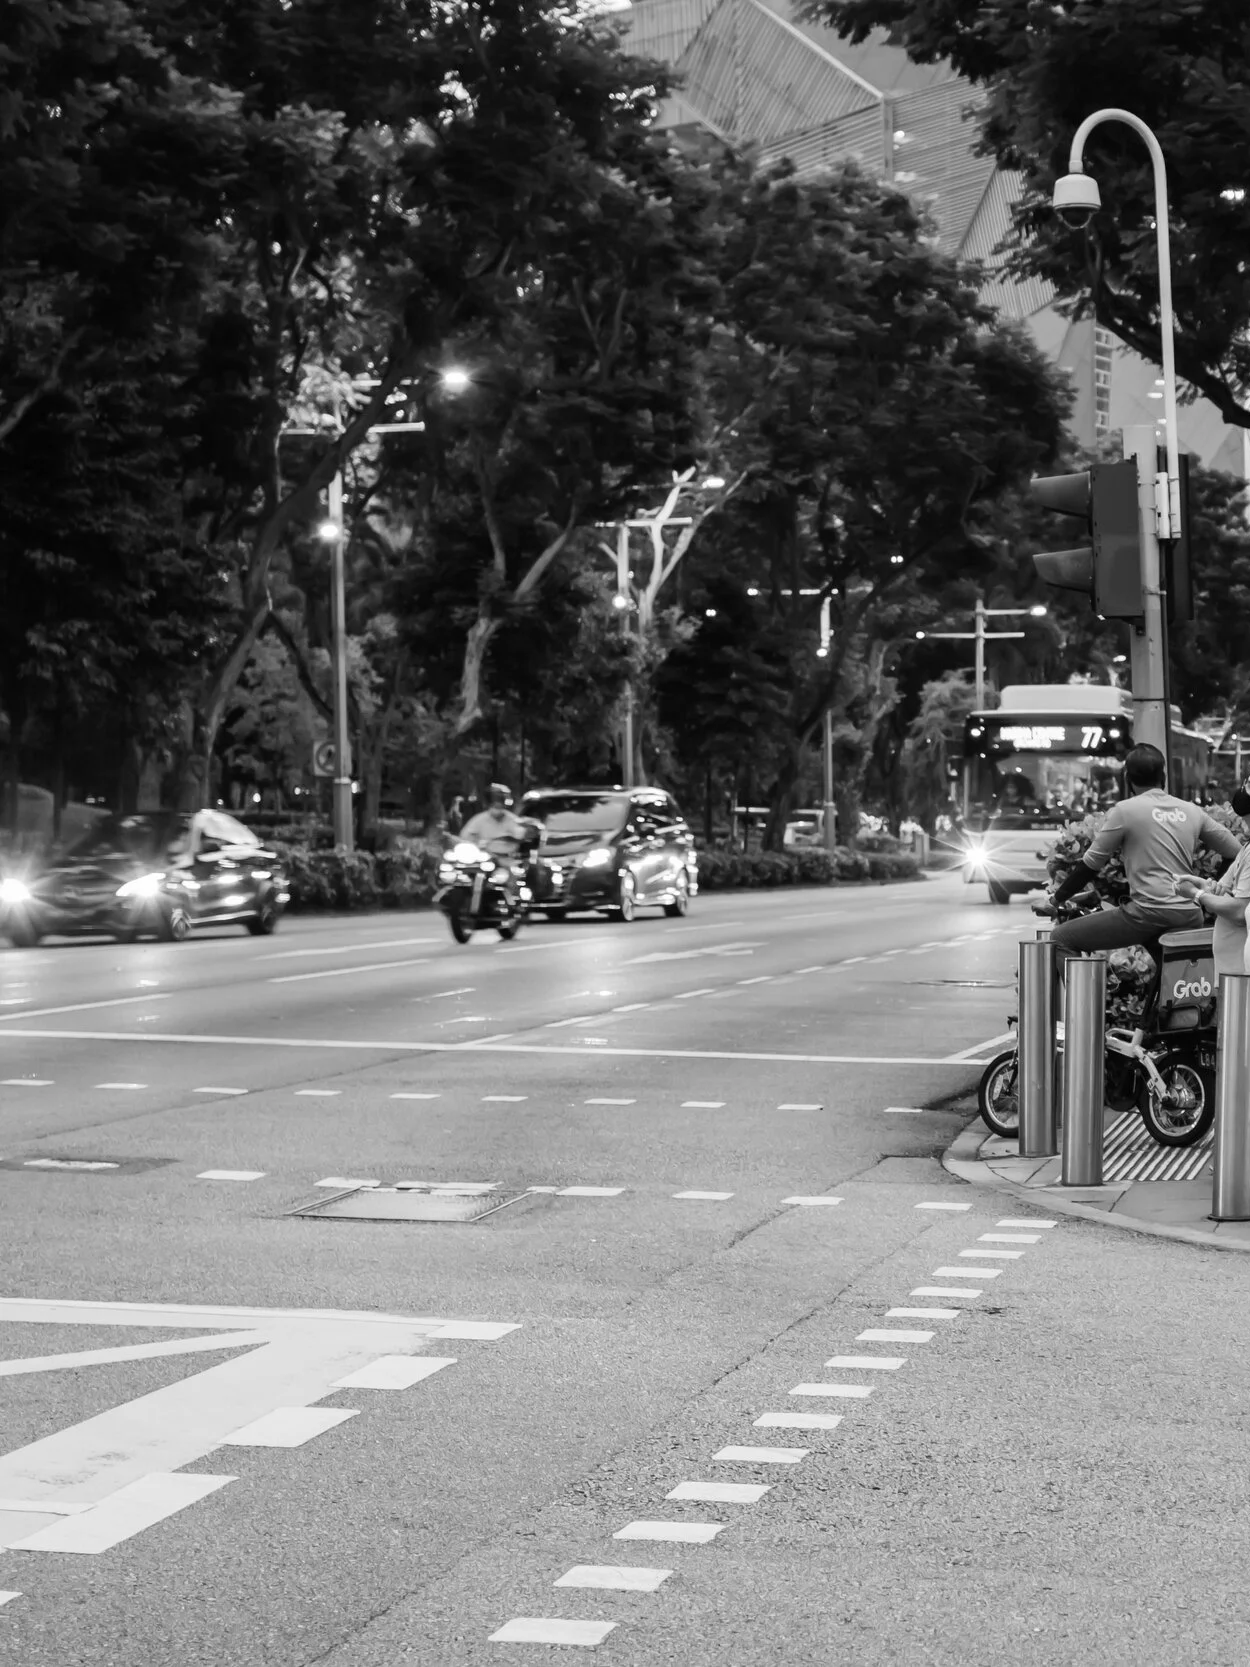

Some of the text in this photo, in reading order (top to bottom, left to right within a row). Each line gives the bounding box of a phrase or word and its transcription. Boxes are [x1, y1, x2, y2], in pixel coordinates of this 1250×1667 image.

[1081, 726, 1103, 749] 77
[1151, 807, 1187, 823] Grab
[1173, 976, 1212, 999] Grab
